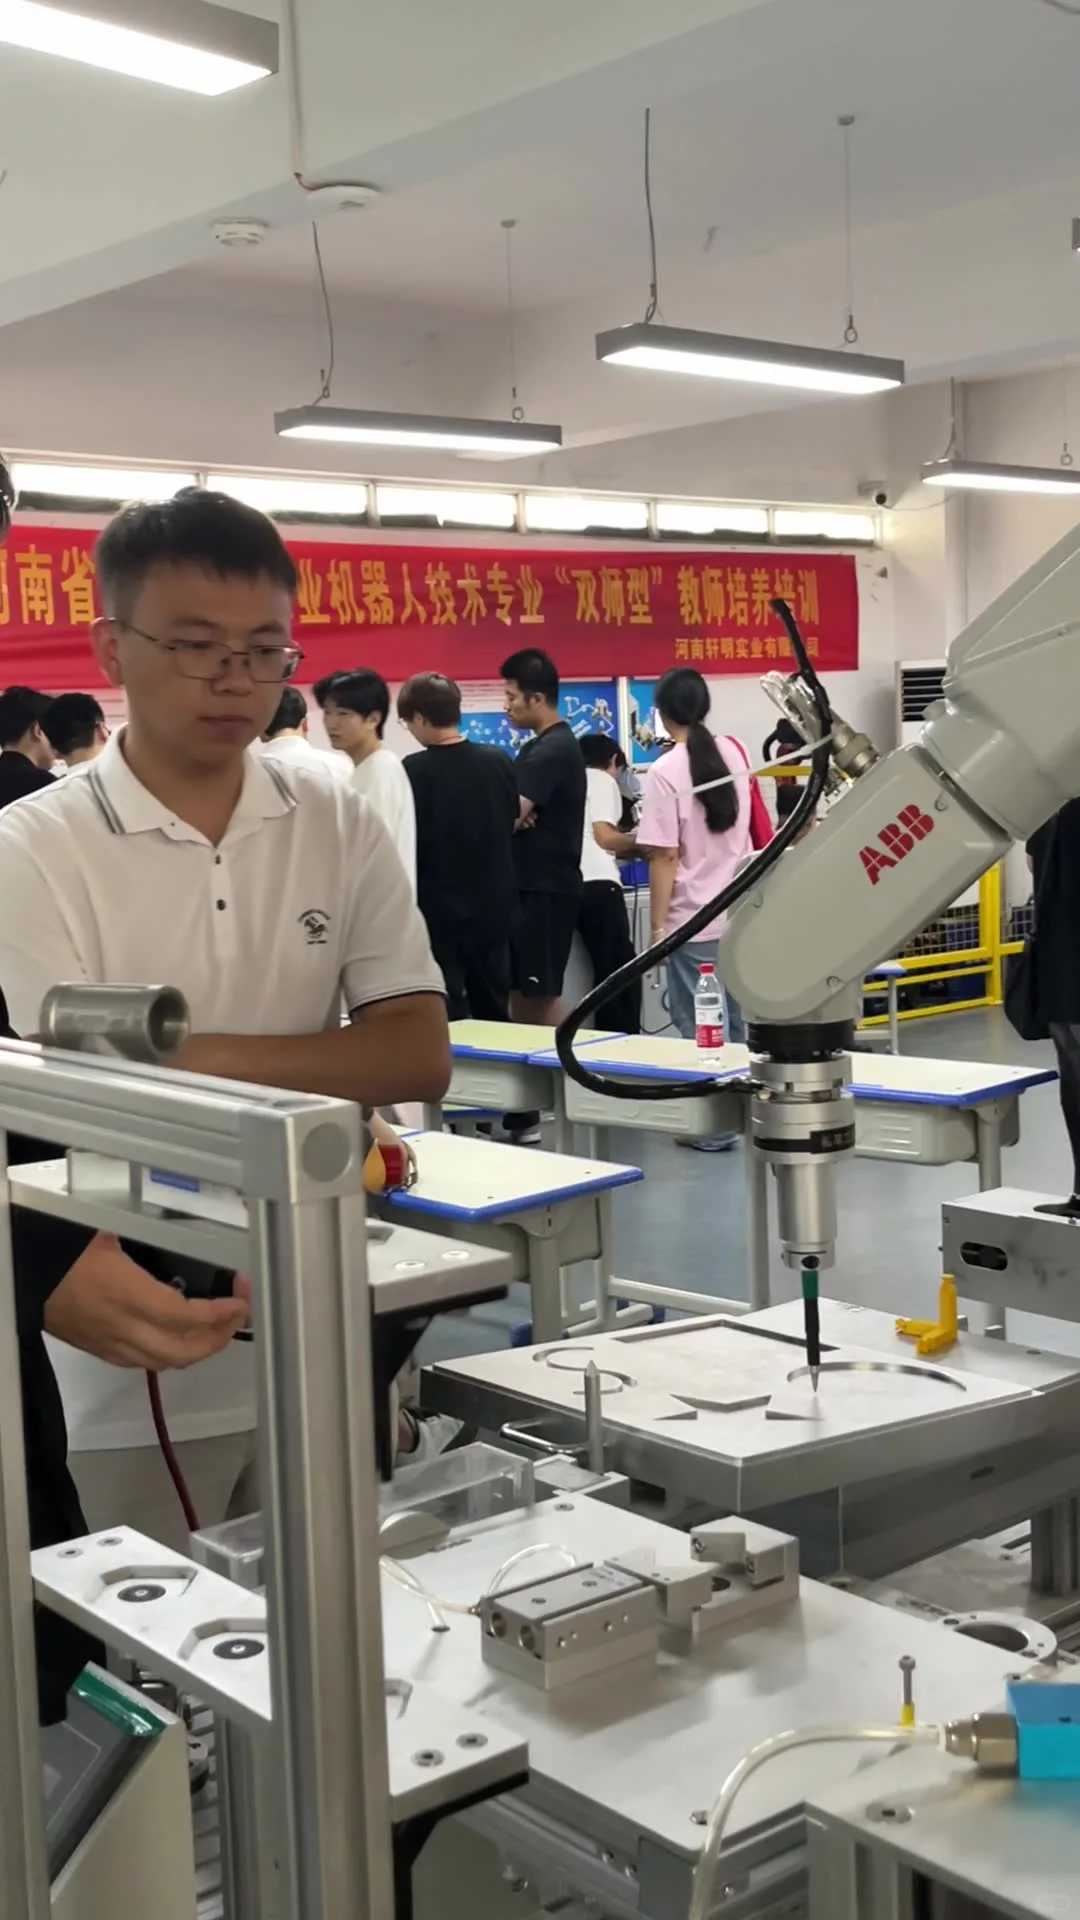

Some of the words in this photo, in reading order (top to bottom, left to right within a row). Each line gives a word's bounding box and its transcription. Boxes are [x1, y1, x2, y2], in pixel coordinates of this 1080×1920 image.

[675, 636, 818, 660] 河南轩明实业有限司
[859, 804, 934, 885] ABB
